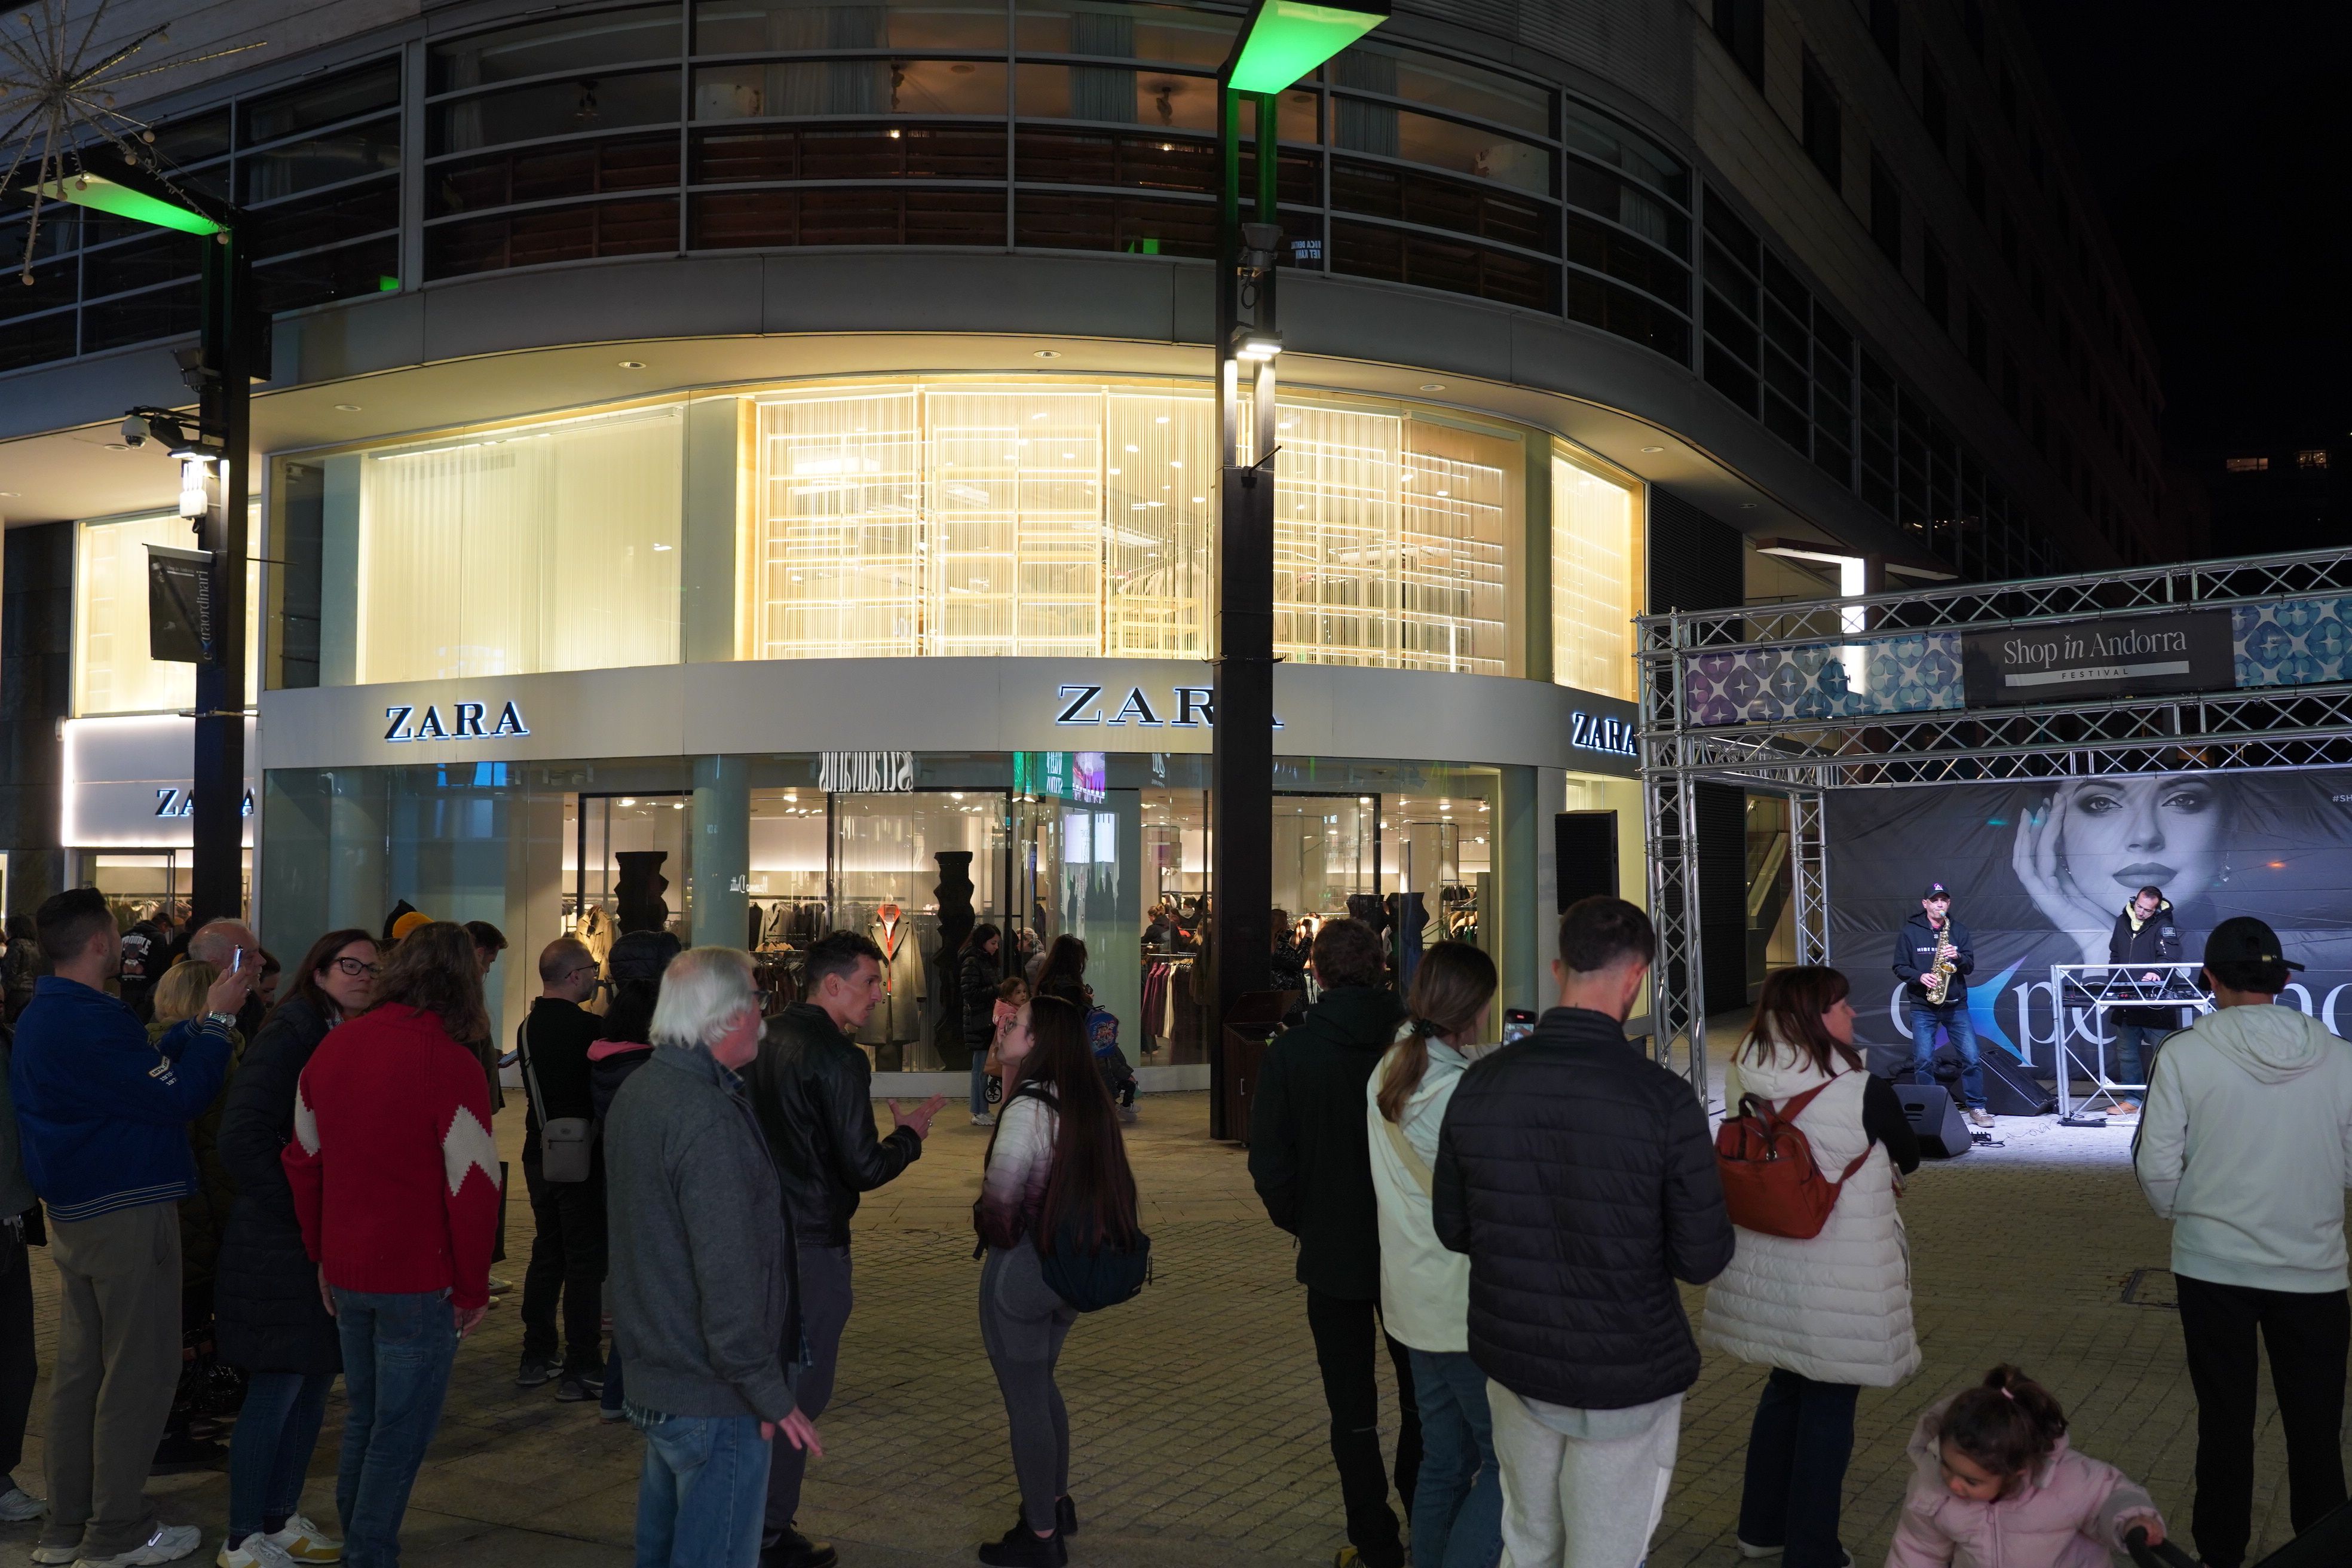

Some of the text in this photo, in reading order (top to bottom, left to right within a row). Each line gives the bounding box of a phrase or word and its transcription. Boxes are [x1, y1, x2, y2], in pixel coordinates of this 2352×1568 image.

[2004, 629, 2187, 669] Shop in Andorra
[2062, 668, 2129, 680] FESTIVAL
[384, 701, 529, 741] ZARA
[1056, 685, 1285, 728] ZAR
[1573, 713, 1640, 755] ZARA
[155, 789, 255, 816] ZAA
